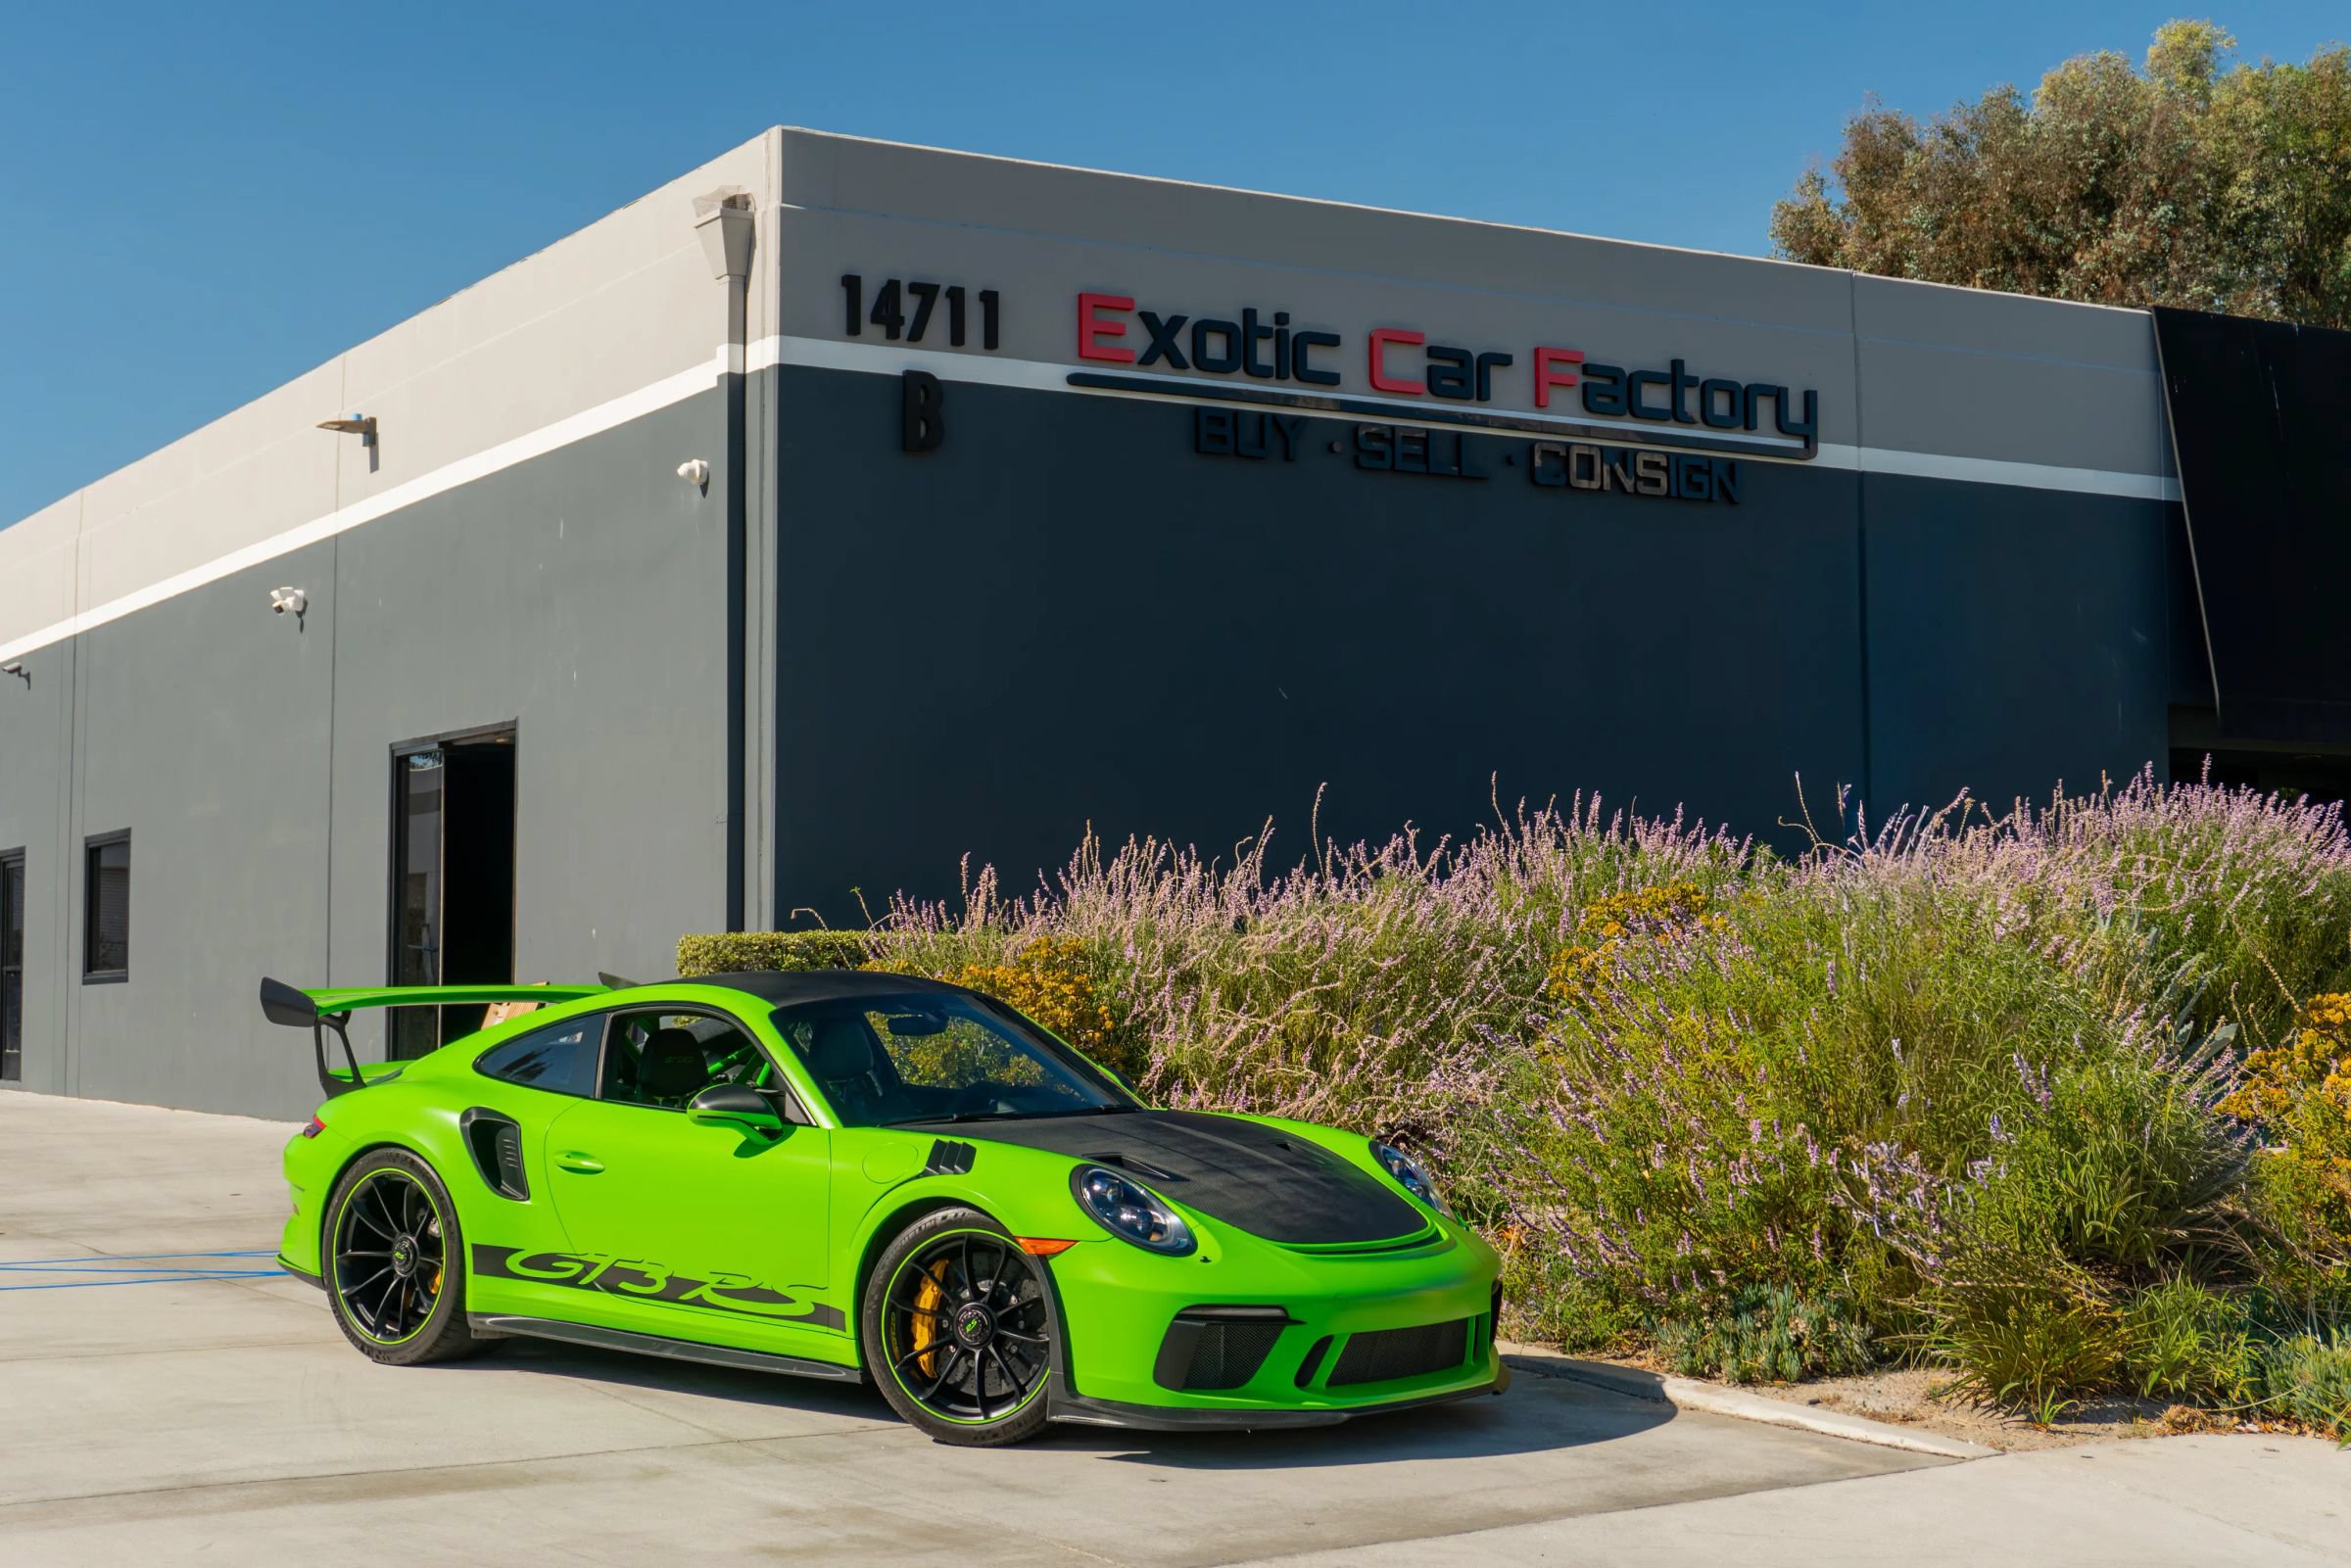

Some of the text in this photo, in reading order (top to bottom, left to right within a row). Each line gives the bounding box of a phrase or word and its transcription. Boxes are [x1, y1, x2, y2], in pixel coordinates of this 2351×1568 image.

[840, 273, 999, 351] 14711
[901, 368, 945, 453] B
[1078, 291, 1818, 459] Exotic Car Factory
[1194, 404, 1741, 505] BUY SELL CONSIGN
[504, 1249, 830, 1317] GT3 RS
